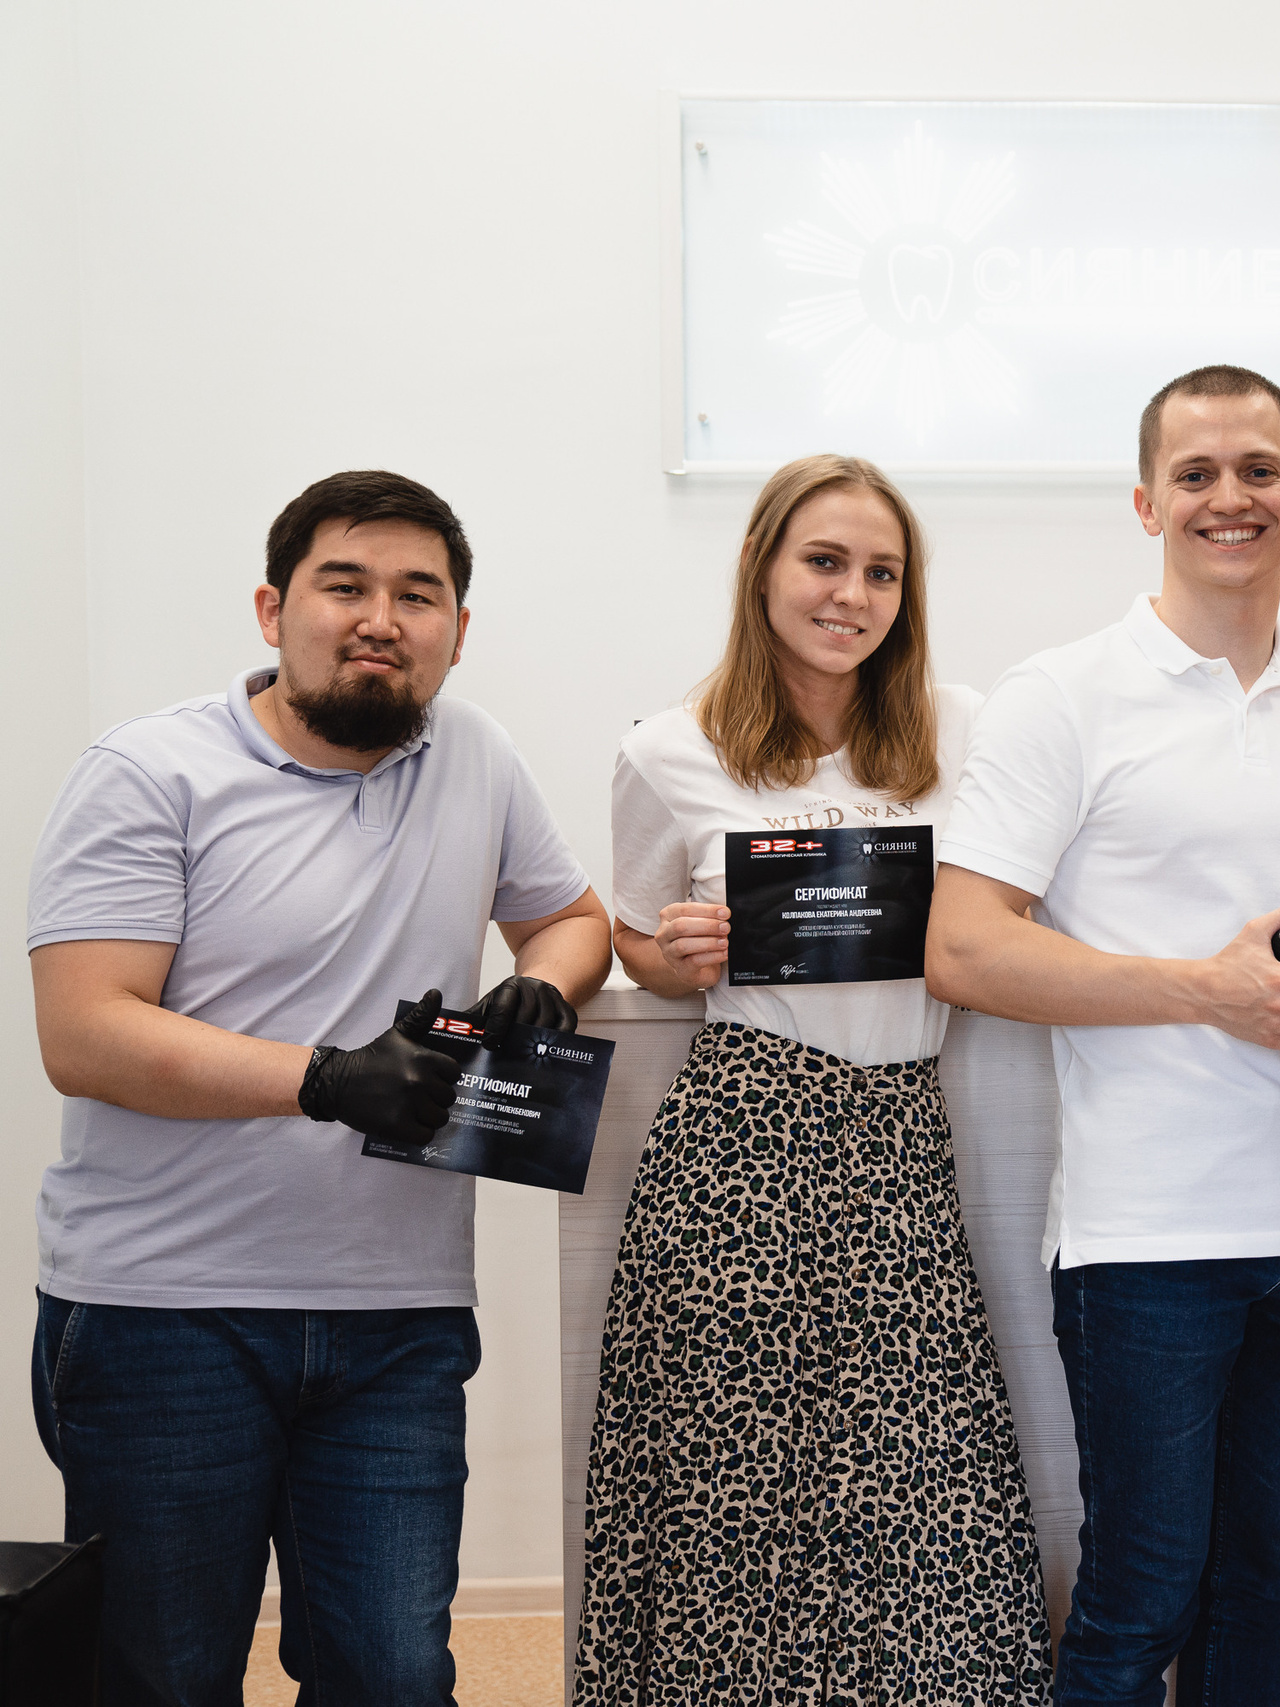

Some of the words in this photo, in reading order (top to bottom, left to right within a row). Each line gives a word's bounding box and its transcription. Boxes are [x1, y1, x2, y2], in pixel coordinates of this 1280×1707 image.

[762, 807, 844, 830] WILD
[853, 801, 917, 818] WAY
[750, 839, 823, 853] 32+
[874, 841, 917, 851] СИЯНИЕ
[794, 886, 868, 901] СЕРТИФИКАТ
[781, 911, 815, 919] КОЛПАКОВА
[816, 910, 848, 918] ЕКАТЕРИНА
[849, 908, 882, 917] АНДРЕЕВНА
[428, 1030, 476, 1043] МАТОЛОГИЧЕСКАЯ
[548, 1046, 595, 1062] СИЯНИЕ
[457, 1073, 532, 1099] СЕРТИФИКАТ
[455, 1096, 476, 1107] ЛДАЕВ
[476, 1101, 496, 1111] САМАТ
[496, 1105, 541, 1119] ТИЛЕКБЕКОВИЧ
